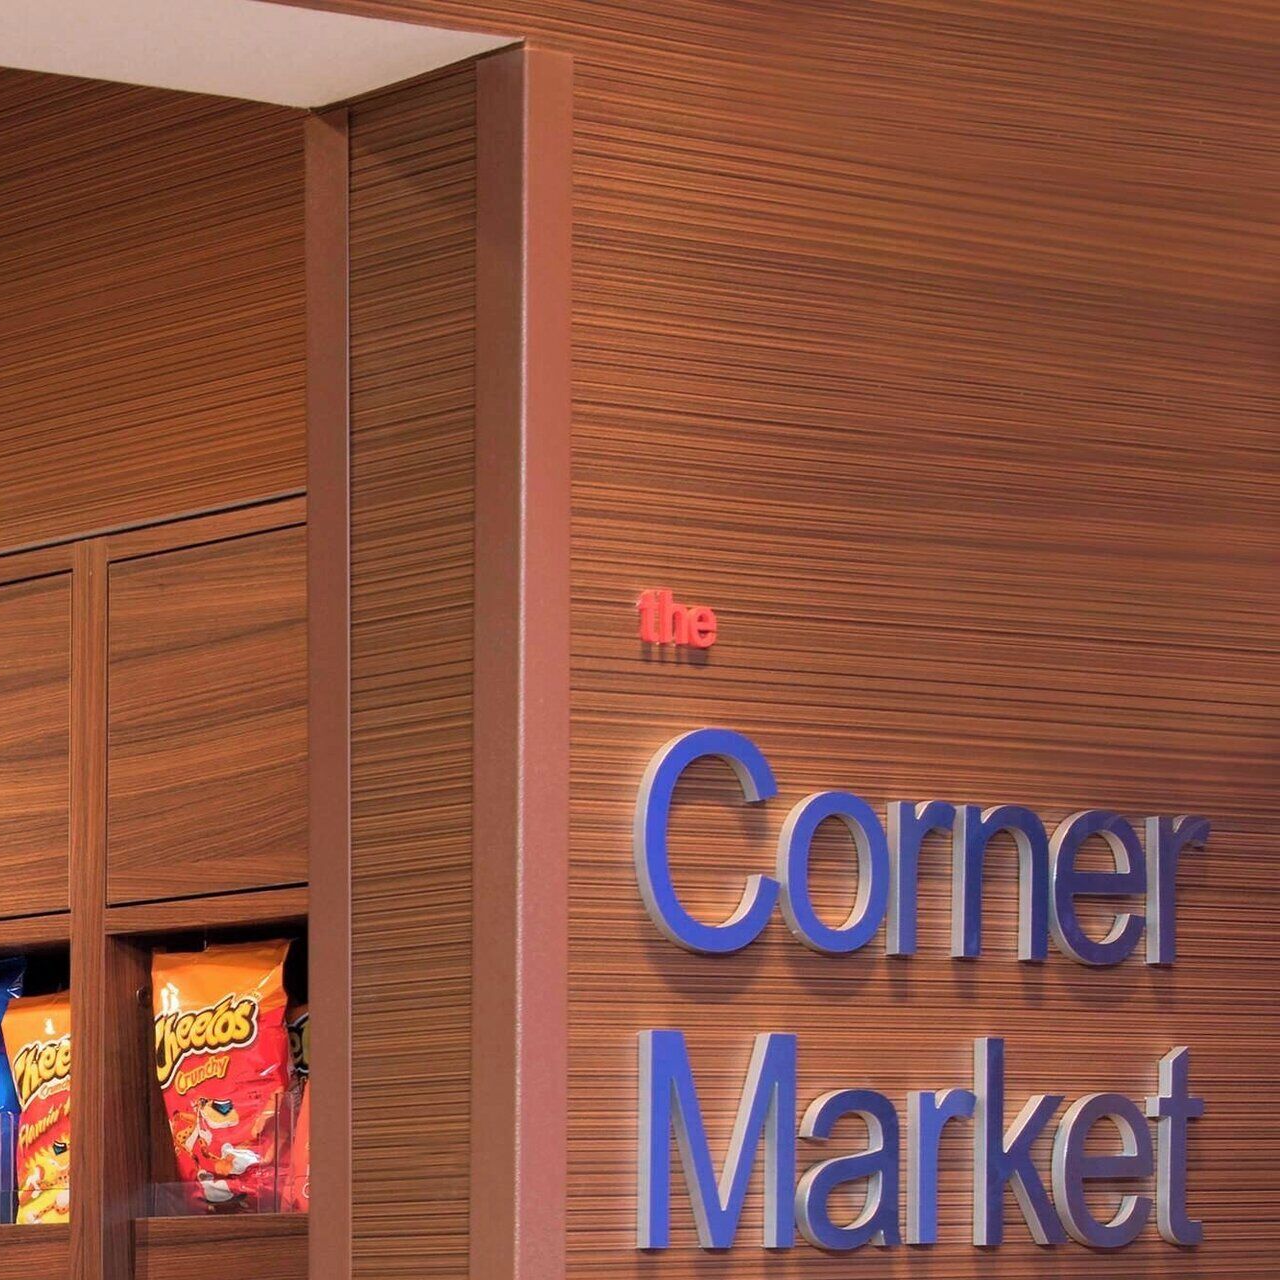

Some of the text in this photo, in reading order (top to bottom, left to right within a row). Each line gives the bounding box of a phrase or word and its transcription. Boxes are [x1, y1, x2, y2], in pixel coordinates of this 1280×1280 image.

[637, 589, 717, 649] the
[633, 727, 1211, 966] Corner
[14, 1039, 70, 1107] Chee
[174, 1055, 231, 1094] Crunchy
[636, 1029, 1204, 1250] Market
